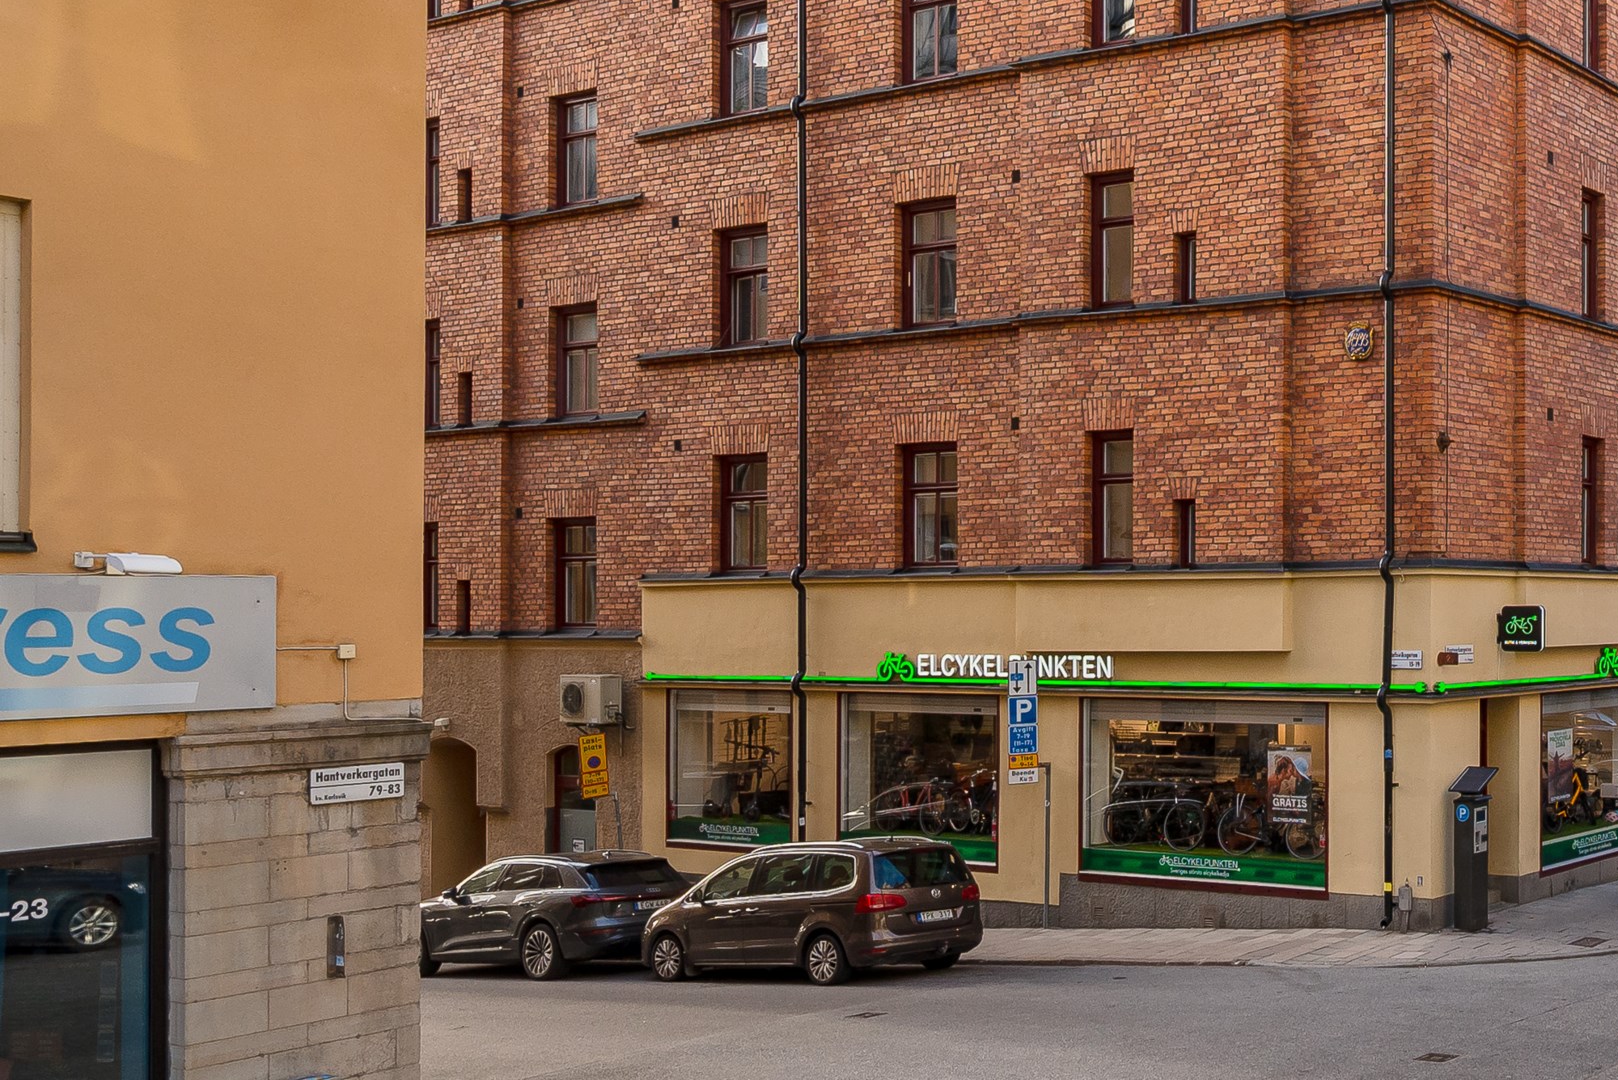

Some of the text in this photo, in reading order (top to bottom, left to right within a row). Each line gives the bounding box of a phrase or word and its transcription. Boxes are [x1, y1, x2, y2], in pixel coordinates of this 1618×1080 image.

[0, 606, 215, 678] ess
[917, 653, 1113, 679] ELCYKELNKTEN
[1016, 698, 1033, 723] P
[1012, 726, 1034, 734] Avgift
[315, 767, 401, 783] Hantverkargatan
[368, 783, 401, 797] 79-83
[1272, 798, 1308, 809] GRATIS
[1459, 807, 1467, 819] P
[1172, 856, 1239, 869] ELCYKELPUNKTEN
